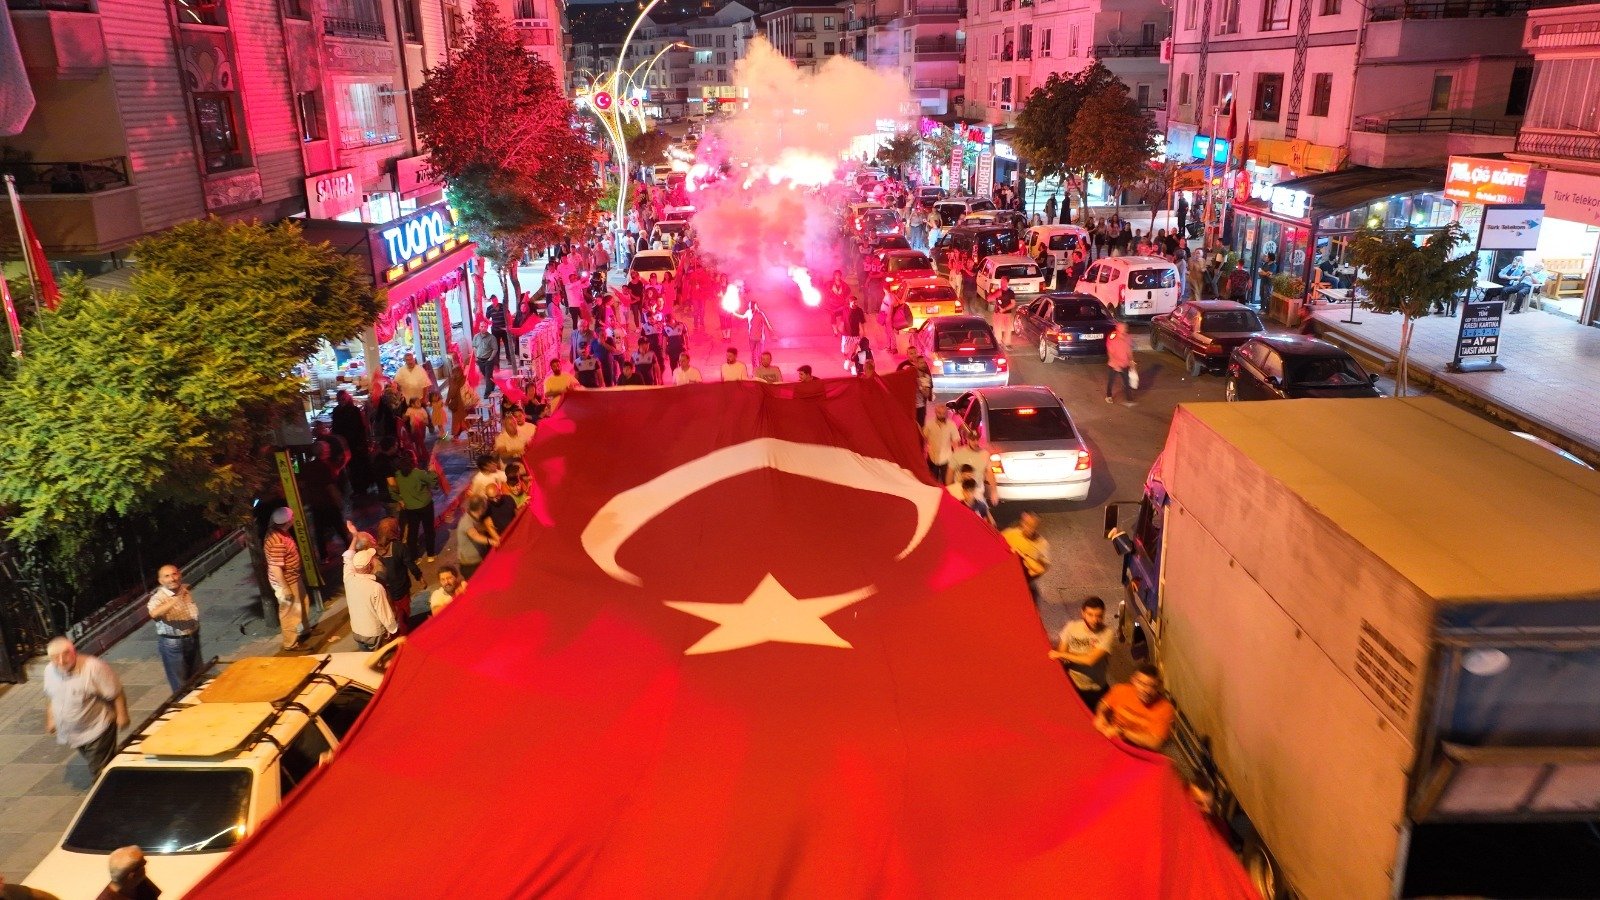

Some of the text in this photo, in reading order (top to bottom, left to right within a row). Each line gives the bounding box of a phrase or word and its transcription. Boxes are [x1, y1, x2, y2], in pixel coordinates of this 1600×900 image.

[316, 173, 355, 202] SAHRA
[1553, 190, 1600, 207] Türk Teleko
[1473, 337, 1485, 346] AY
